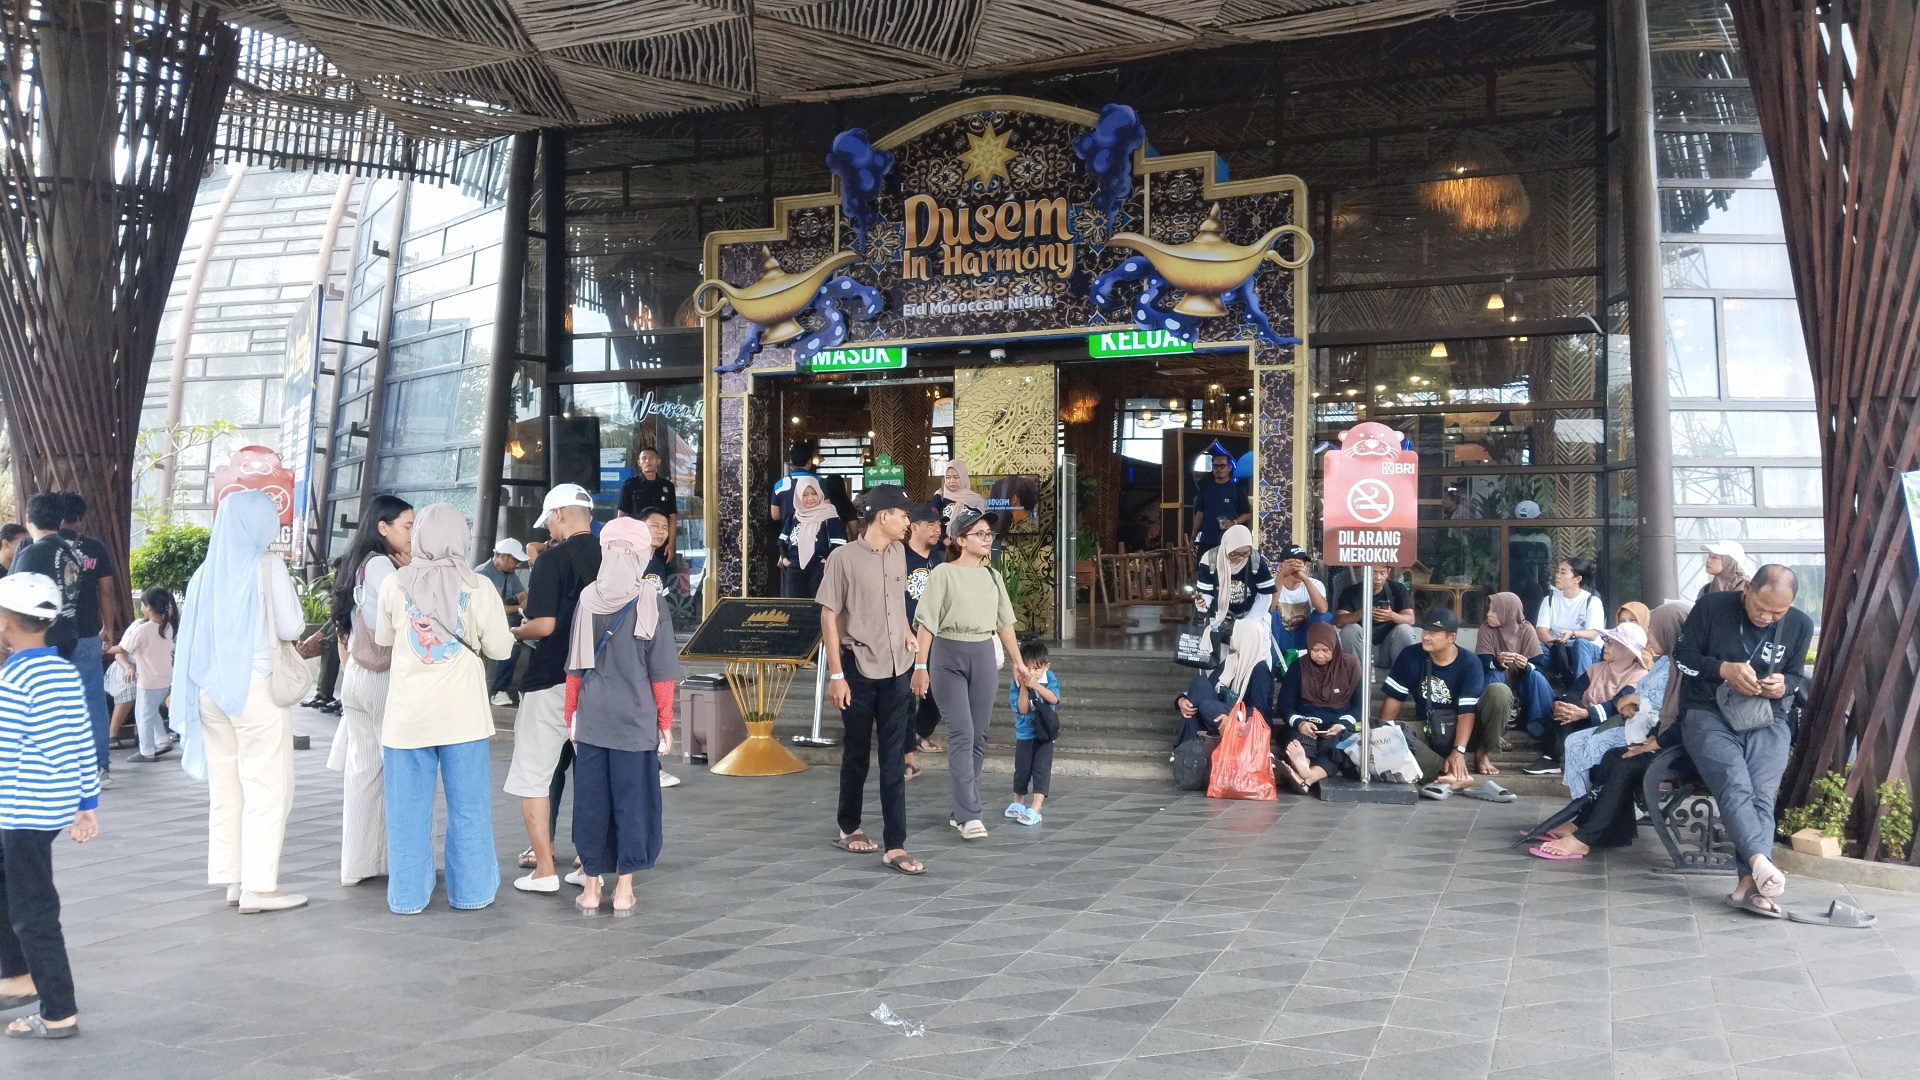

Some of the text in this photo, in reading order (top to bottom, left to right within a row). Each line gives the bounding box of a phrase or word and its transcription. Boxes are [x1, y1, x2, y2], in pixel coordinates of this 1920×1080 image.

[904, 193, 1075, 249] Dusem
[903, 242, 1074, 281] In Harmony
[902, 294, 1054, 317] Eid Moroccan Night
[812, 347, 891, 366] MASUK
[1395, 463, 1415, 474] BRI
[1338, 530, 1401, 546] DILARANG
[1339, 547, 1399, 563] MEROKOK
